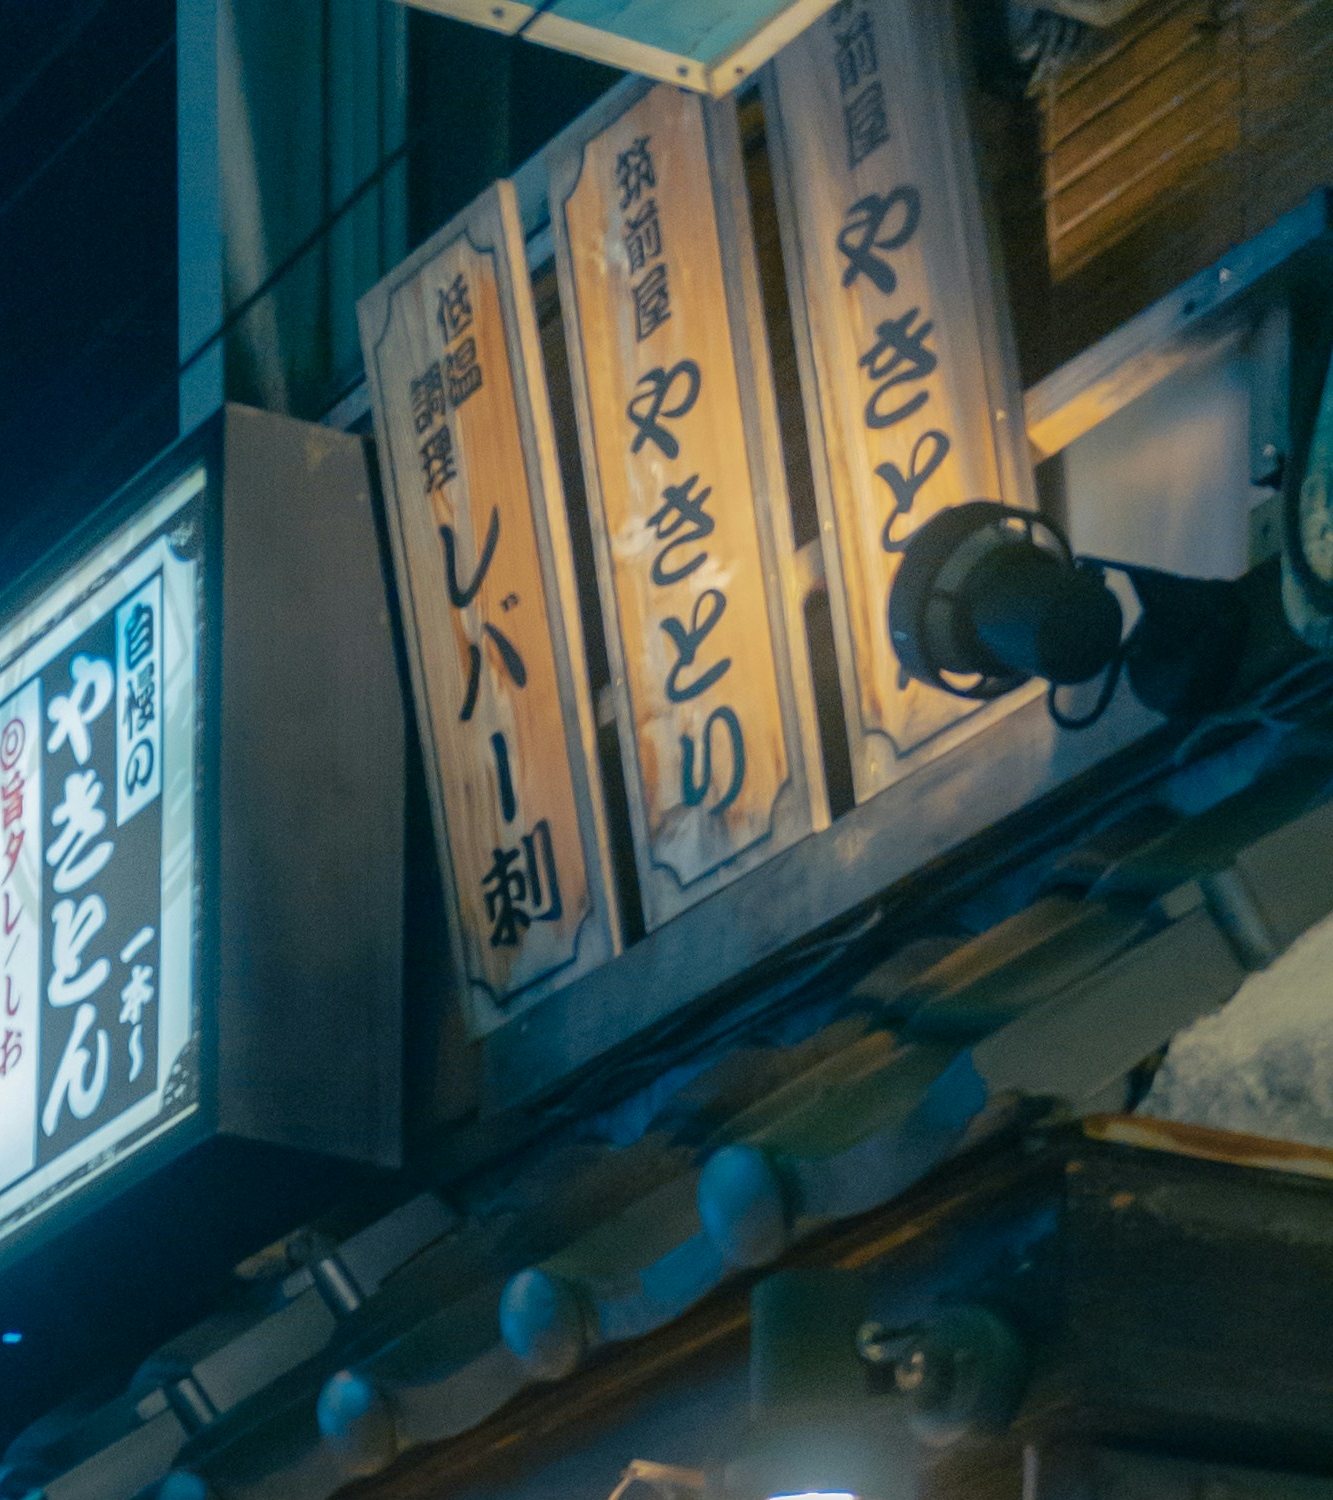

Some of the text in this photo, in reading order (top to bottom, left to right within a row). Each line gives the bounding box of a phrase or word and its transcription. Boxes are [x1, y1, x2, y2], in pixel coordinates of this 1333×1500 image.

[616, 137, 746, 814] 筑前屋 やきとり
[836, 183, 950, 600] やきと
[42, 654, 114, 1137] やきとん
[122, 603, 156, 797] 自慢の
[440, 505, 561, 948] レバー刺
